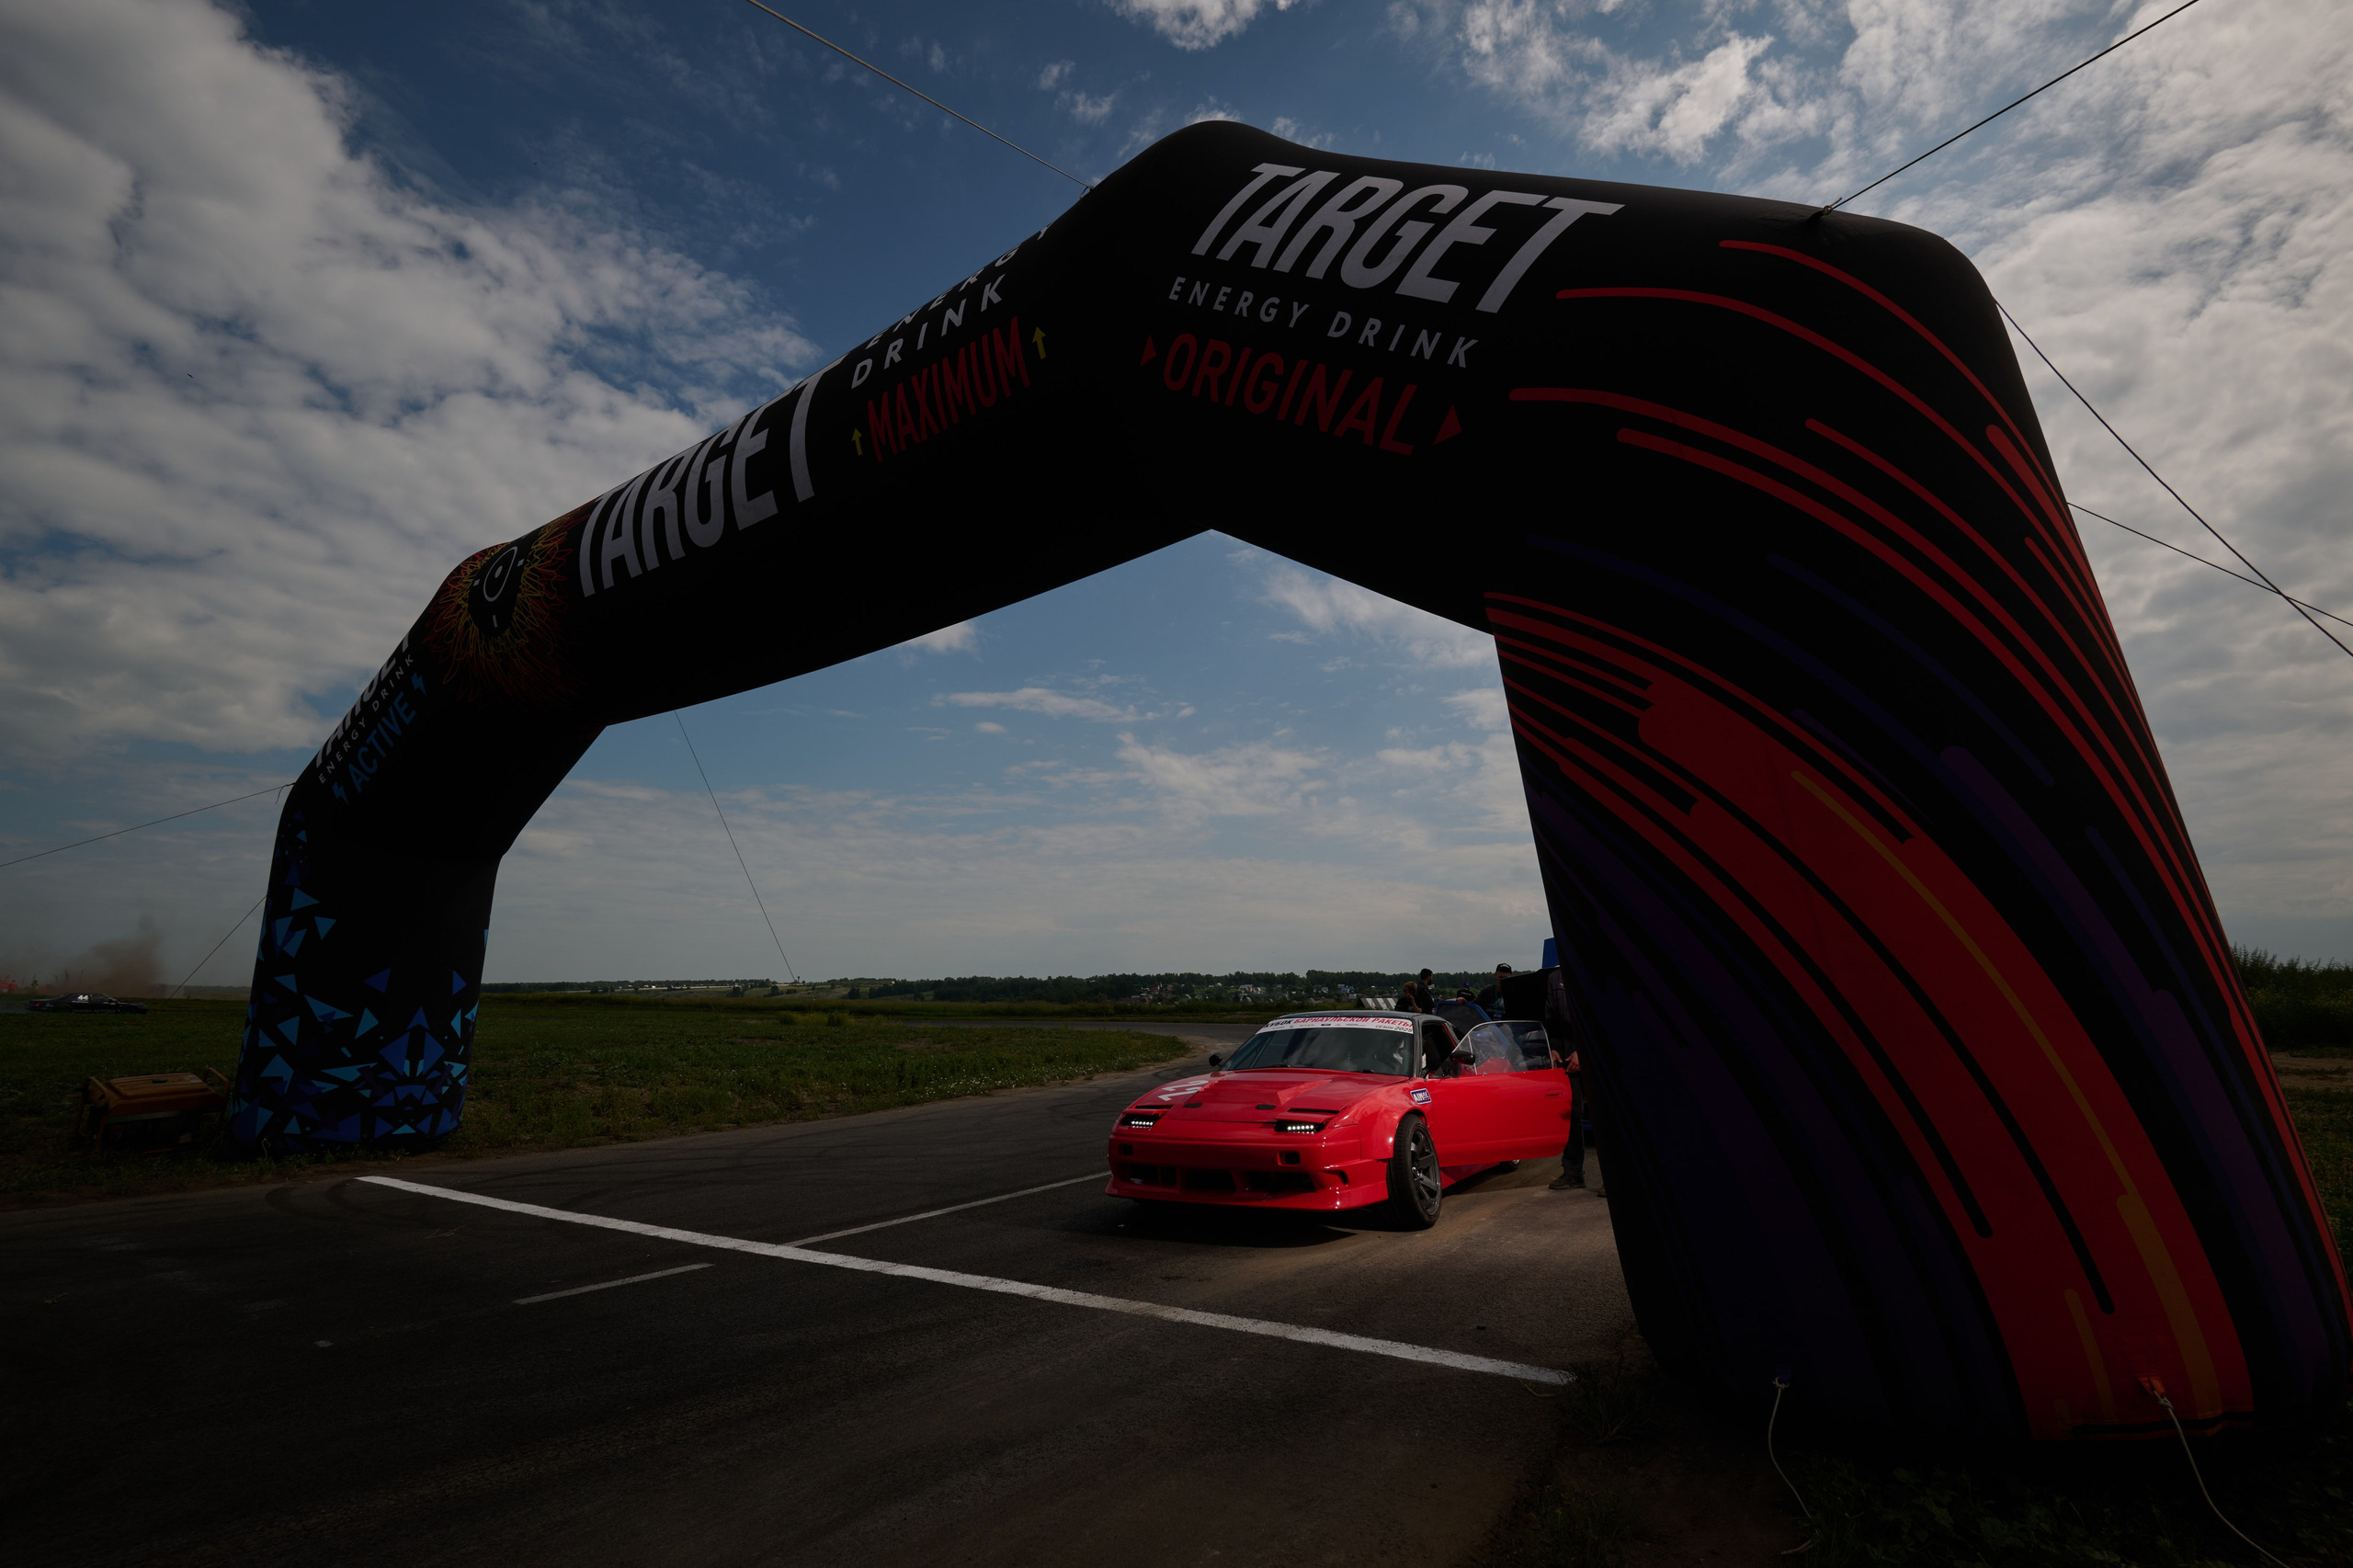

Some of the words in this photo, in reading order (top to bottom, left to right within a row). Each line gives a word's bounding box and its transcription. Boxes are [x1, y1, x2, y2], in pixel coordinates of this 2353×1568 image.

[1191, 163, 1626, 313] TARGET
[851, 274, 1006, 390] DRINK
[1168, 276, 1312, 330] ENERGY
[1327, 311, 1479, 369] DRINK
[867, 315, 1032, 463] MAXIMUM
[1163, 332, 1418, 457] ORIGINAL
[579, 355, 847, 598] TARGET
[318, 716, 367, 784] ENERGY
[372, 653, 414, 712] DRINK
[347, 690, 417, 794] ACTIVE
